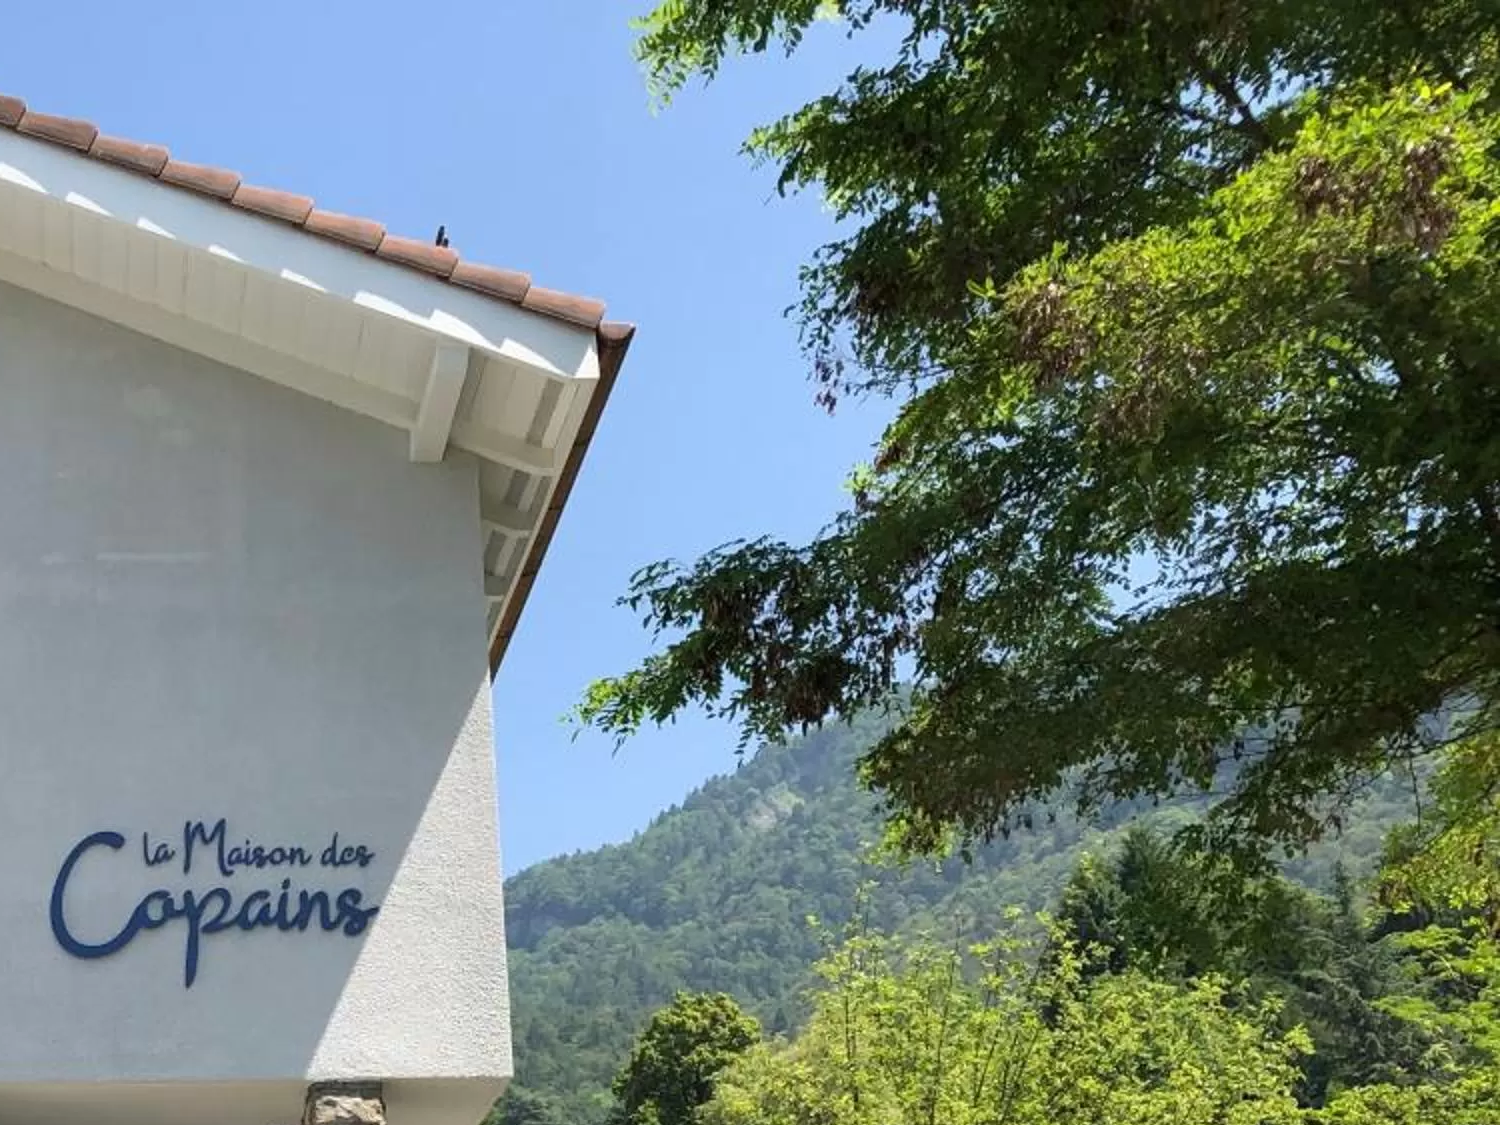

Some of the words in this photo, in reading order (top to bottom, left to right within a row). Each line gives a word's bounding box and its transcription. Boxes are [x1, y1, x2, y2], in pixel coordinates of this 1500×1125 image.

[144, 832, 175, 867] la
[183, 817, 312, 877] Maison
[320, 832, 375, 867] des
[49, 830, 381, 990] Copains
